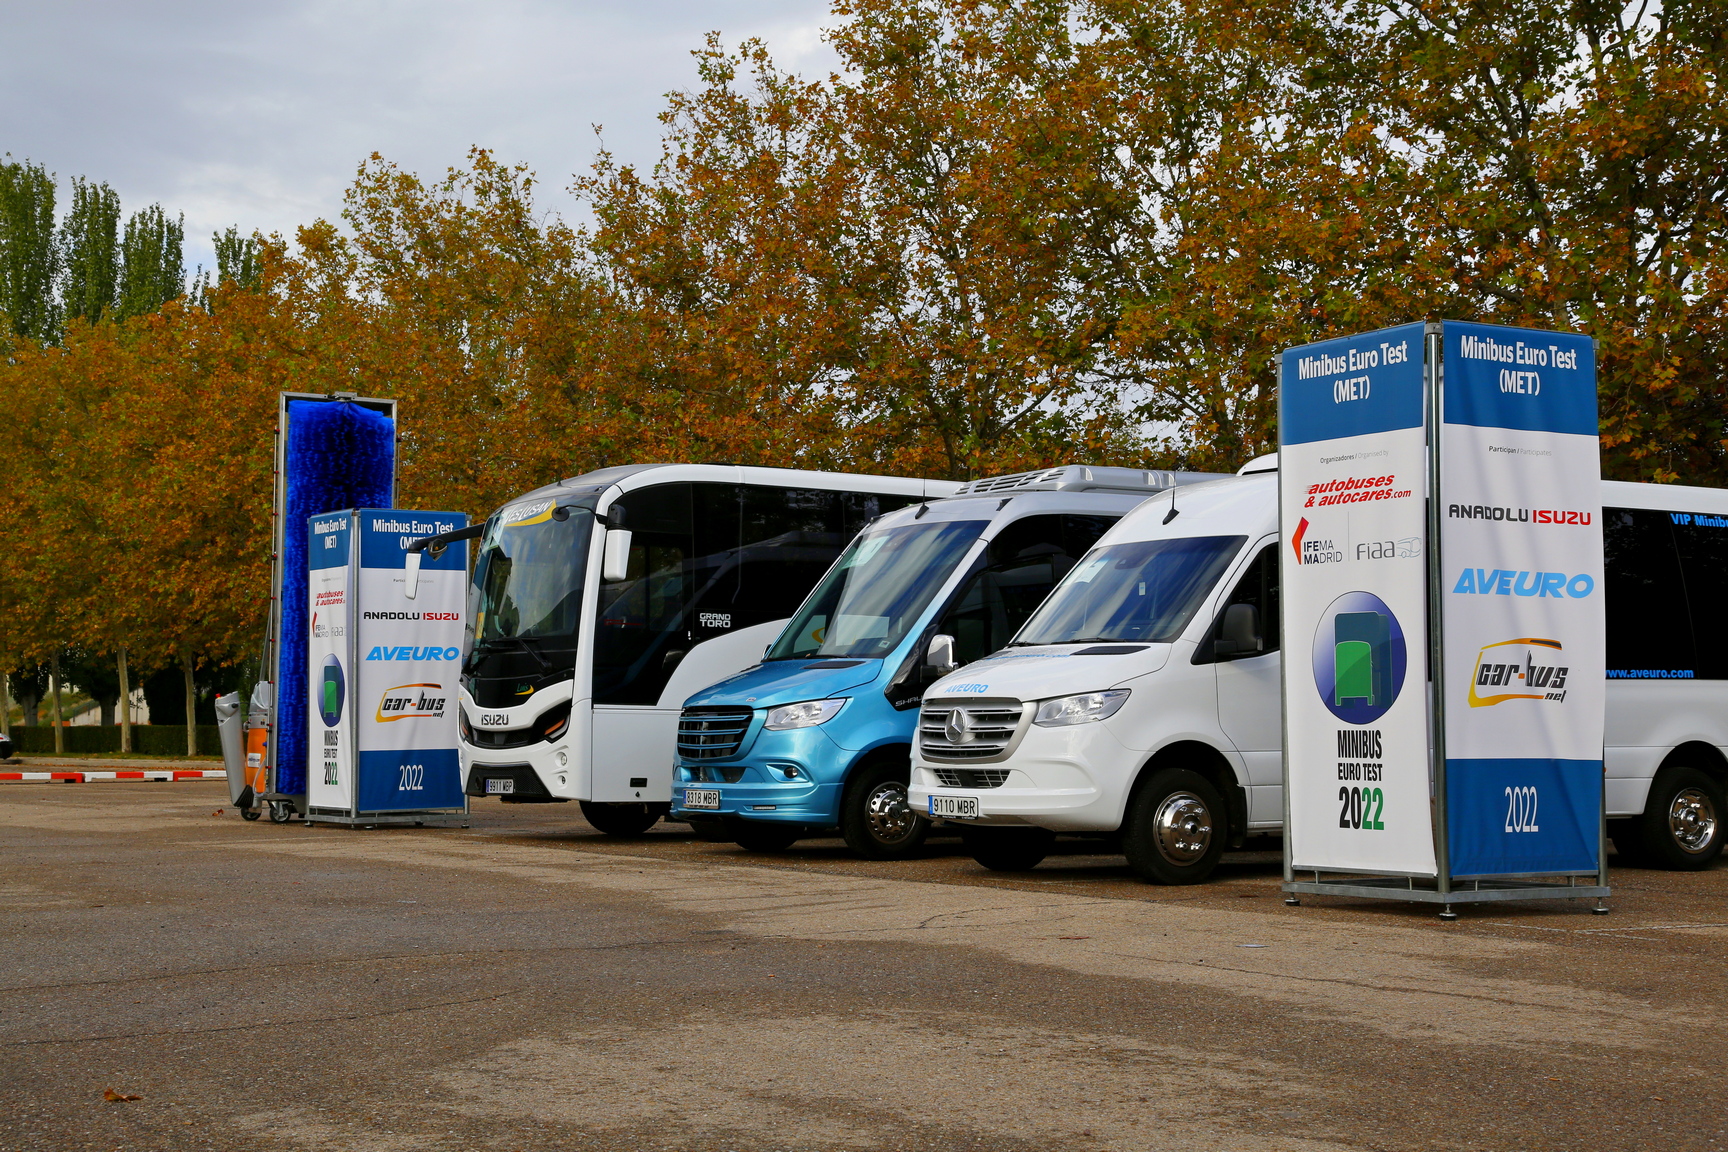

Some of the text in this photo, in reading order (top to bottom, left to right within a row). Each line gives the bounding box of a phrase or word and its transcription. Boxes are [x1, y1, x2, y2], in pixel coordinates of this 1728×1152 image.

[1299, 341, 1408, 380] Minibus Euro Test
[1461, 335, 1577, 370] Minibus Euro Test
[1333, 375, 1370, 404] (MET)
[1500, 368, 1540, 396] (MET)
[1488, 445, 1517, 454] Participan
[1308, 475, 1395, 495] autobuses
[1304, 488, 1412, 508] & autocares.com
[1449, 504, 1591, 526] ANADOLU ISUZU
[1670, 513, 1691, 525] VIP
[373, 519, 454, 534] Minibus Euro Test
[1303, 540, 1334, 552] IFEMA
[1304, 551, 1343, 565] MADRID
[1452, 568, 1595, 599] AVEURO
[363, 611, 459, 621] ANADOLU ISUZU
[699, 612, 731, 621] GRAND
[699, 619, 731, 628] TORO
[365, 646, 460, 661] AVEURO
[1476, 650, 1569, 689] car-bus
[943, 683, 989, 694] AVEURO
[1544, 690, 1567, 704] net
[381, 689, 446, 711] car-bus
[432, 710, 445, 718] net
[481, 714, 509, 726] ISUZU
[1337, 729, 1383, 760] MINIBUS
[323, 761, 339, 785] 2022
[399, 764, 424, 791] 2022
[1338, 762, 1383, 782] EURO TEST
[686, 791, 717, 805] 8318 MBR
[933, 798, 976, 814] 9110 MBR
[1338, 786, 1385, 830] 2022
[1504, 786, 1539, 833] 2022
